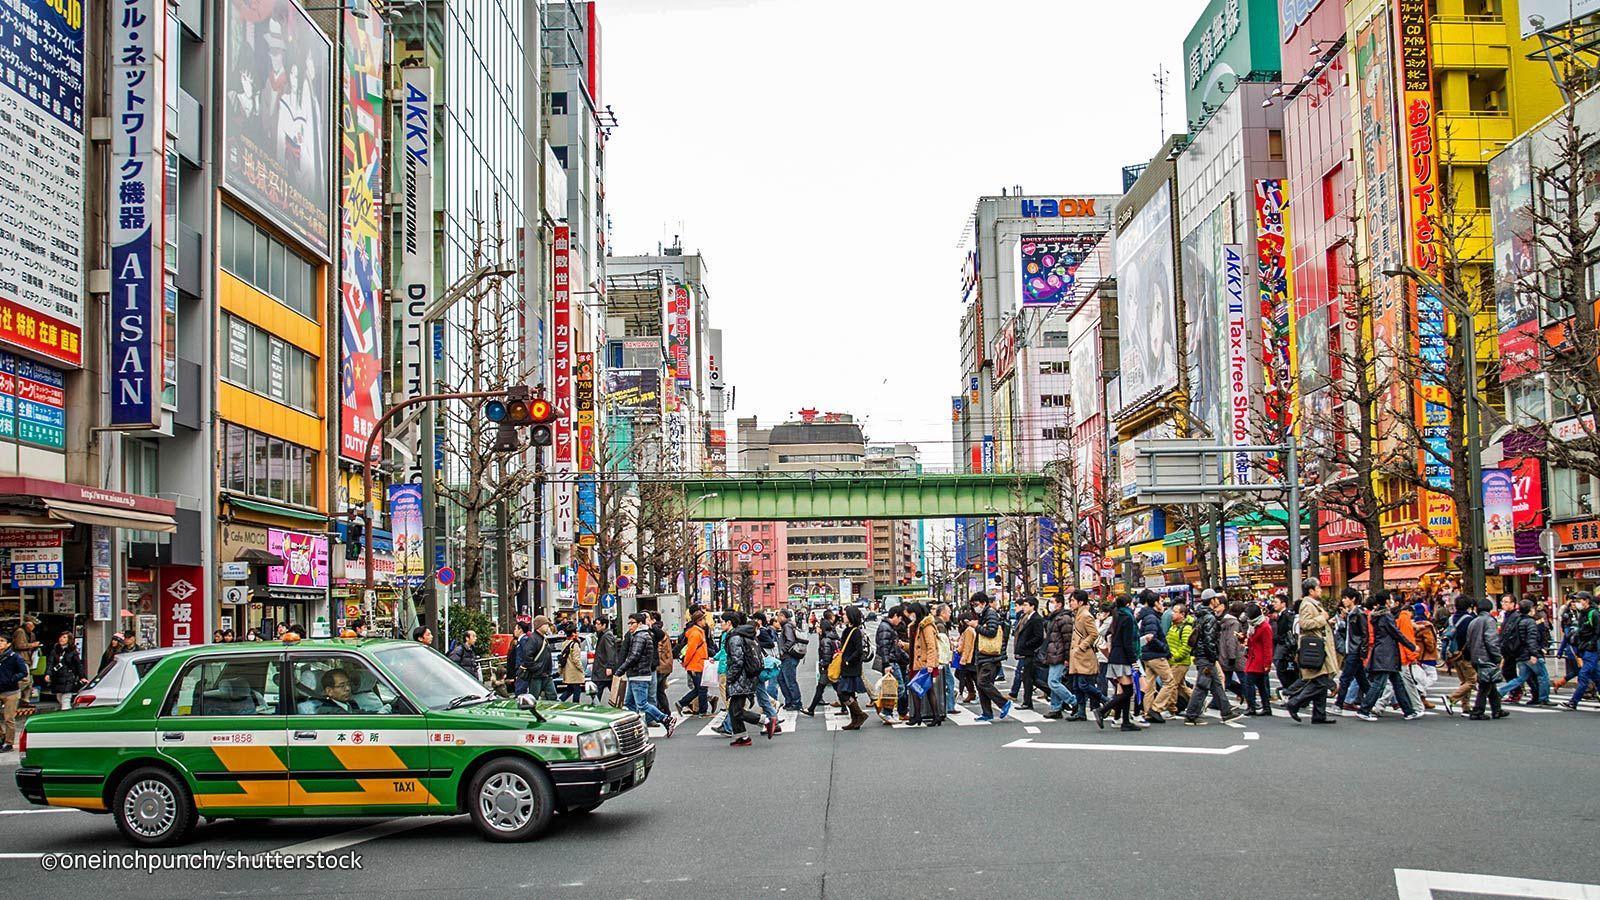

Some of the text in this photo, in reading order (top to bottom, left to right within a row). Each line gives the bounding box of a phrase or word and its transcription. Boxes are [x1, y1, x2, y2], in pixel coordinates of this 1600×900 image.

[1401, 4, 1424, 13] ブルーレイ
[1402, 15, 1424, 24] ゲーム
[1406, 26, 1421, 35] CD
[1403, 36, 1425, 46] アイドル
[1404, 48, 1426, 57] アニメ
[1405, 59, 1426, 68] コミック
[1407, 70, 1426, 79] ホビー
[1406, 81, 1428, 90] フィギュア
[119, 0, 146, 229] ル・ネットワーク機器
[406, 82, 428, 167] AKKY
[1409, 99, 1436, 270] お売り下さい
[406, 150, 417, 256] INTERNATIONAL
[1226, 248, 1243, 302] AKKY
[118, 253, 145, 405] AISAN
[39, 321, 58, 347] 在庫
[60, 329, 78, 354] 直販
[555, 238, 571, 445] 曲数世界一 カラオケ パセラ
[1230, 317, 1246, 392] Tax-free
[1233, 396, 1248, 442] Shop
[1424, 428, 1433, 436] 1F
[345, 434, 365, 453] DUTY
[1438, 466, 1450, 475] 中古
[1513, 477, 1531, 501] Y!
[558, 467, 570, 532] ダーツバー
[1429, 516, 1452, 525] AKIBA
[230, 531, 243, 543] Cafe
[1572, 523, 1599, 541] 吉野家
[231, 734, 252, 743] 1858
[337, 733, 347, 742] 本
[370, 733, 379, 742] 所
[393, 781, 415, 792] TAXI
